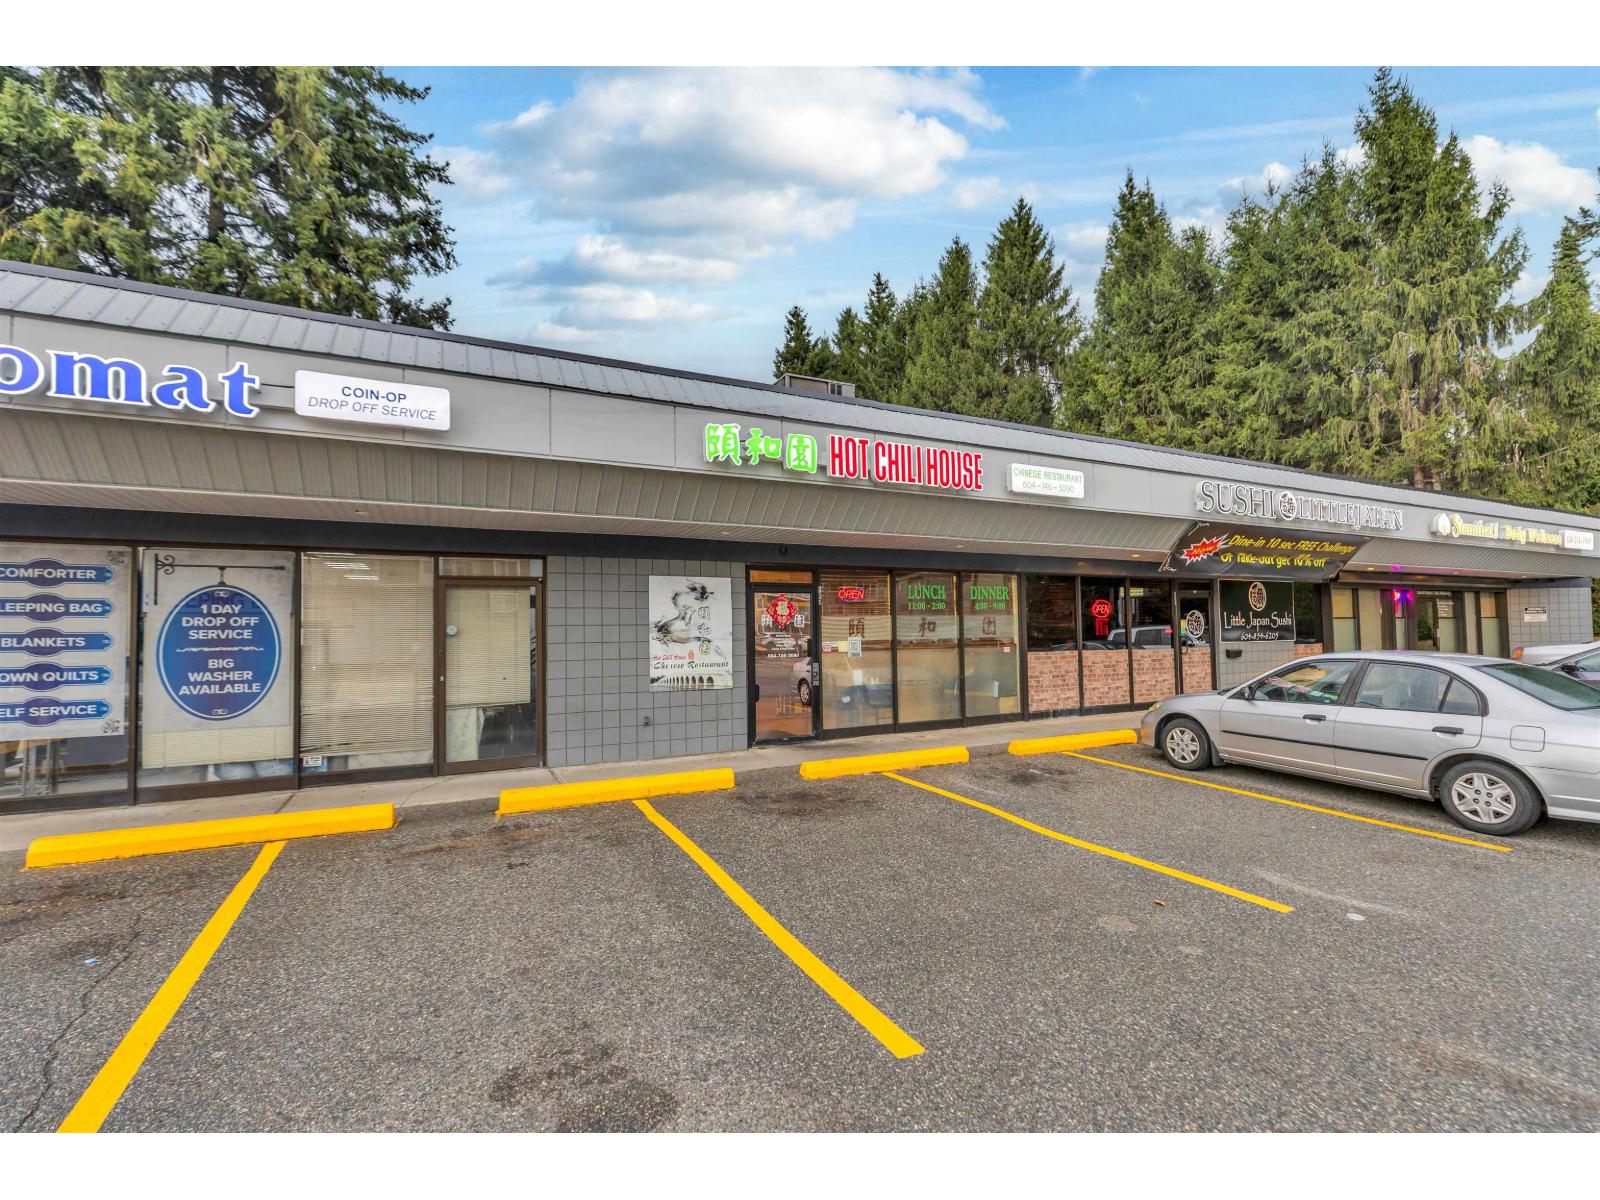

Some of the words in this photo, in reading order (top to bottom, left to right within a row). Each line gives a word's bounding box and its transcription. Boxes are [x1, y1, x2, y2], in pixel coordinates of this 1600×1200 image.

[341, 385, 408, 402] COIN-OP
[307, 396, 349, 412] DROP
[352, 400, 379, 415] OFF
[381, 404, 436, 421] SERVICE
[829, 434, 870, 479] HOT
[873, 440, 923, 486] CHILI
[925, 447, 983, 491] HOUSE
[1013, 467, 1042, 480] CHINESE
[1043, 471, 1083, 484] RESTAURANT
[1200, 481, 1277, 519] SUSHI
[1228, 534, 1266, 548] Dine-in
[1294, 540, 1320, 551] FREE
[1316, 541, 1357, 555] Challenge
[1237, 552, 1275, 565] Take-out
[0, 567, 97, 580] COMFORTER
[838, 587, 865, 600] OPEN
[907, 584, 946, 600] LUNCH
[970, 586, 1009, 600] DINNER
[69, 603, 102, 613] BAG
[201, 604, 208, 614] 1
[211, 604, 242, 614] DAY
[1092, 604, 1111, 615] OPEN
[181, 617, 226, 628] DROP
[229, 616, 259, 627] OFF
[1224, 611, 1246, 629] Little
[1247, 611, 1270, 633] Japan
[1271, 611, 1292, 629] Sushi
[188, 629, 252, 640] SERVICE
[2, 637, 86, 647] BLANKETS
[207, 658, 234, 669] BIG
[687, 660, 729, 669] Restaurant
[43, 670, 98, 682] QUILTS
[188, 670, 253, 682] WASHER
[178, 683, 261, 696] AVAILABLE
[29, 704, 97, 716] SERVICE
